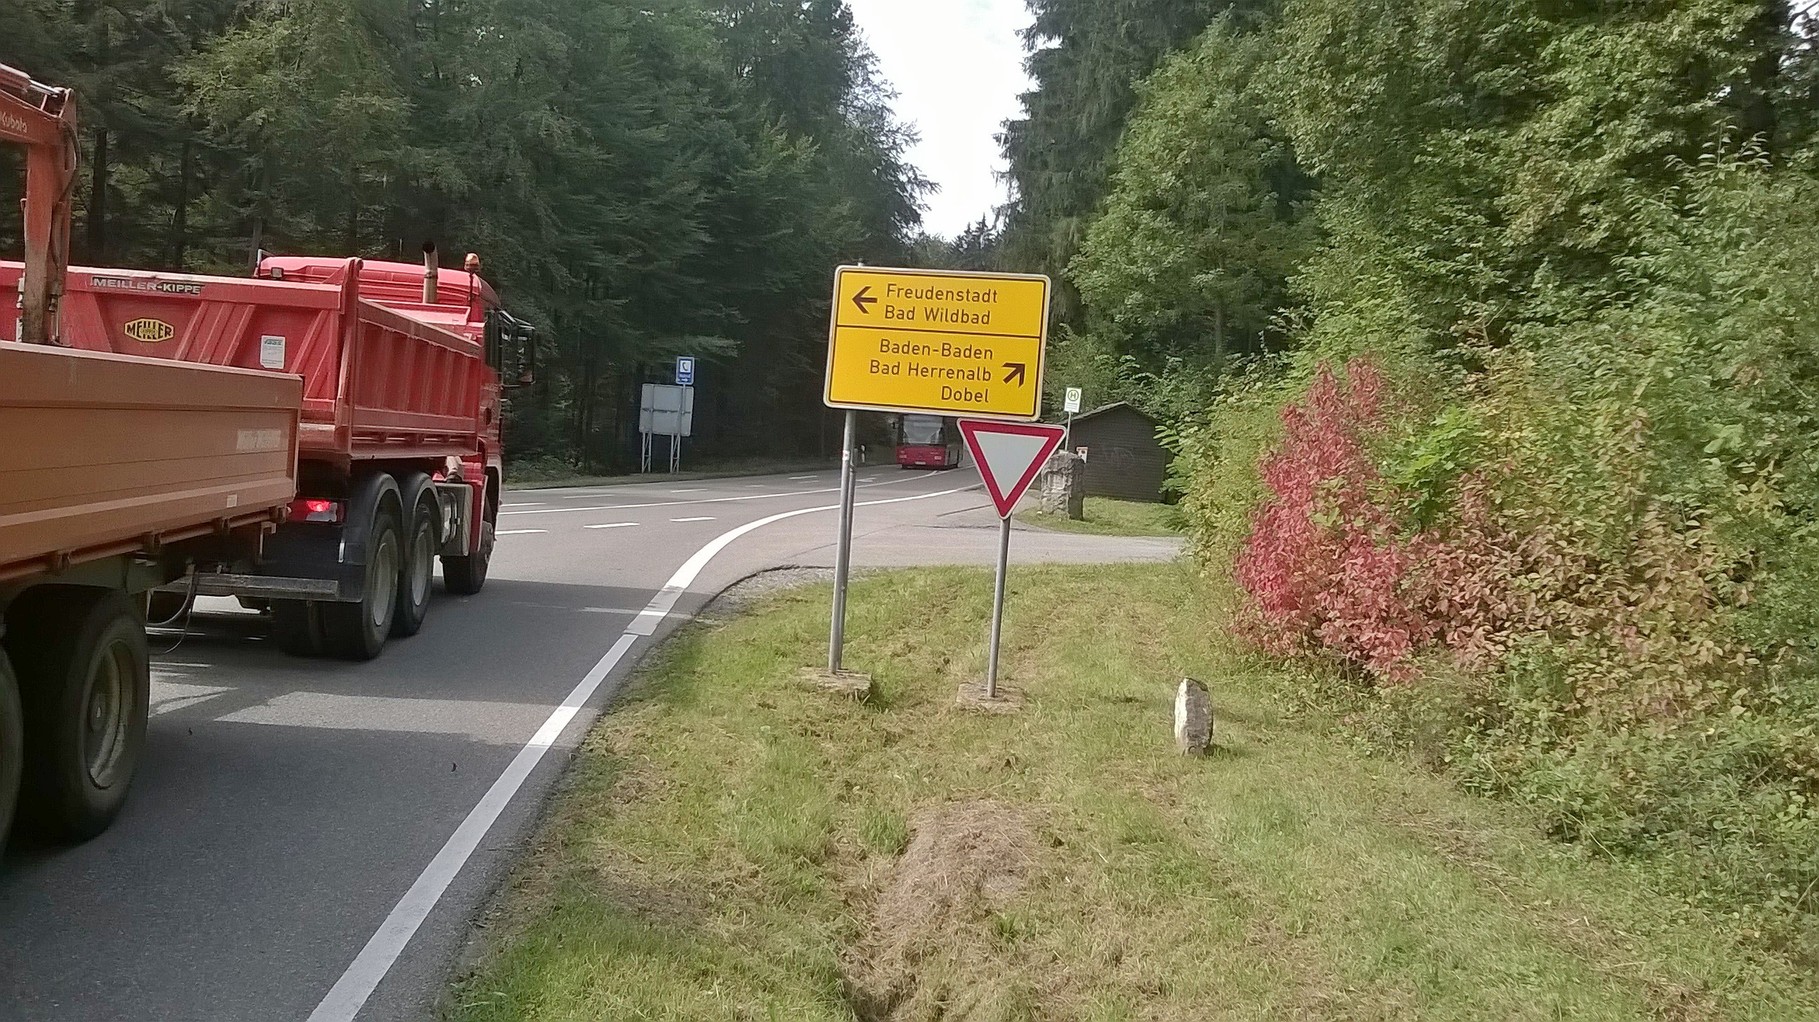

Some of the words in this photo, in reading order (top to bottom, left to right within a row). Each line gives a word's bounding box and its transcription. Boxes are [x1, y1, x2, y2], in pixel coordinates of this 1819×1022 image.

[93, 278, 201, 294] MEILLER-KIPPE
[886, 283, 998, 303] Freudenstadt
[884, 305, 915, 321] Bad
[924, 306, 991, 325] Wildbad
[126, 320, 173, 340] MEILLER
[880, 338, 993, 360] Baden-Baden
[869, 360, 900, 376] Bad
[907, 362, 992, 382] Herrenalb
[941, 386, 989, 403] Dobel
